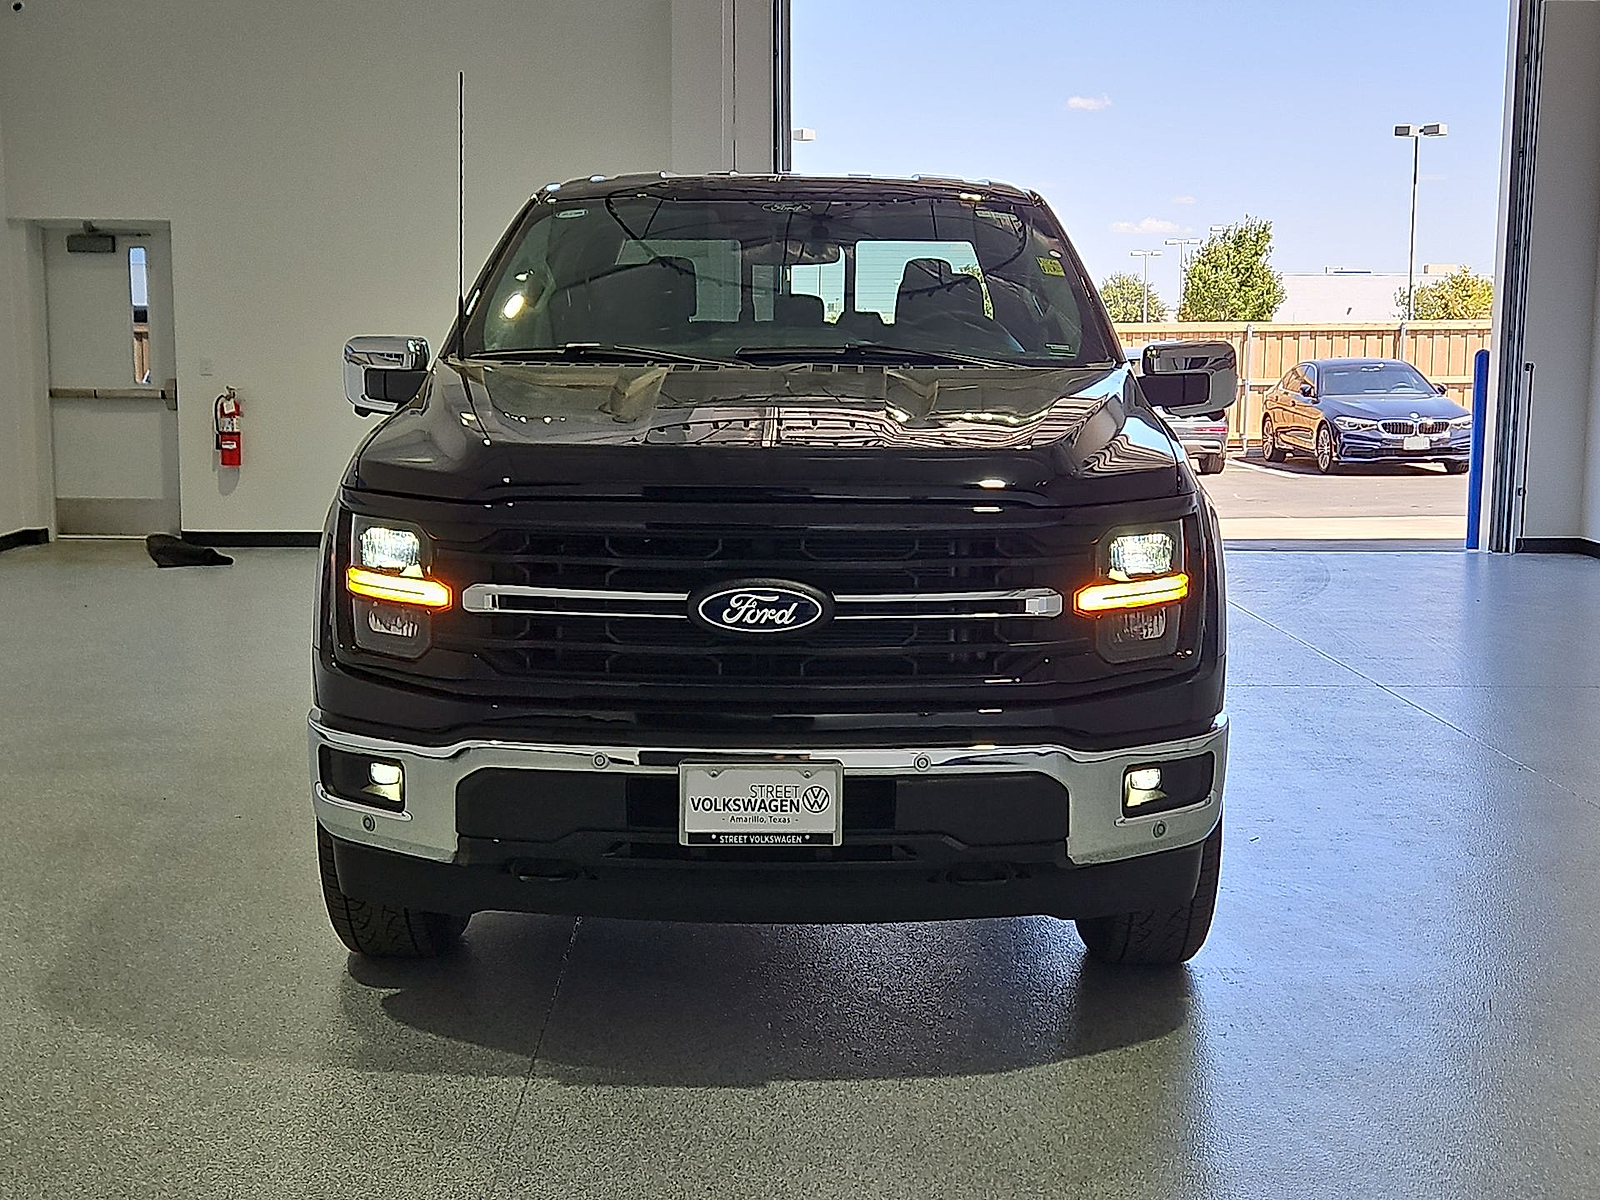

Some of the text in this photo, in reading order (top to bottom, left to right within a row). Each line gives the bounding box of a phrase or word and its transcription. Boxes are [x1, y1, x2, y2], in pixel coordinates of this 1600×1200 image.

[722, 593, 799, 624] Ford
[750, 785, 800, 798] STREET
[690, 797, 800, 812] VOLKSWAGEN
[729, 815, 791, 824] Amarillo, Texas
[719, 835, 802, 843] STREET VOLKSWAGEN
